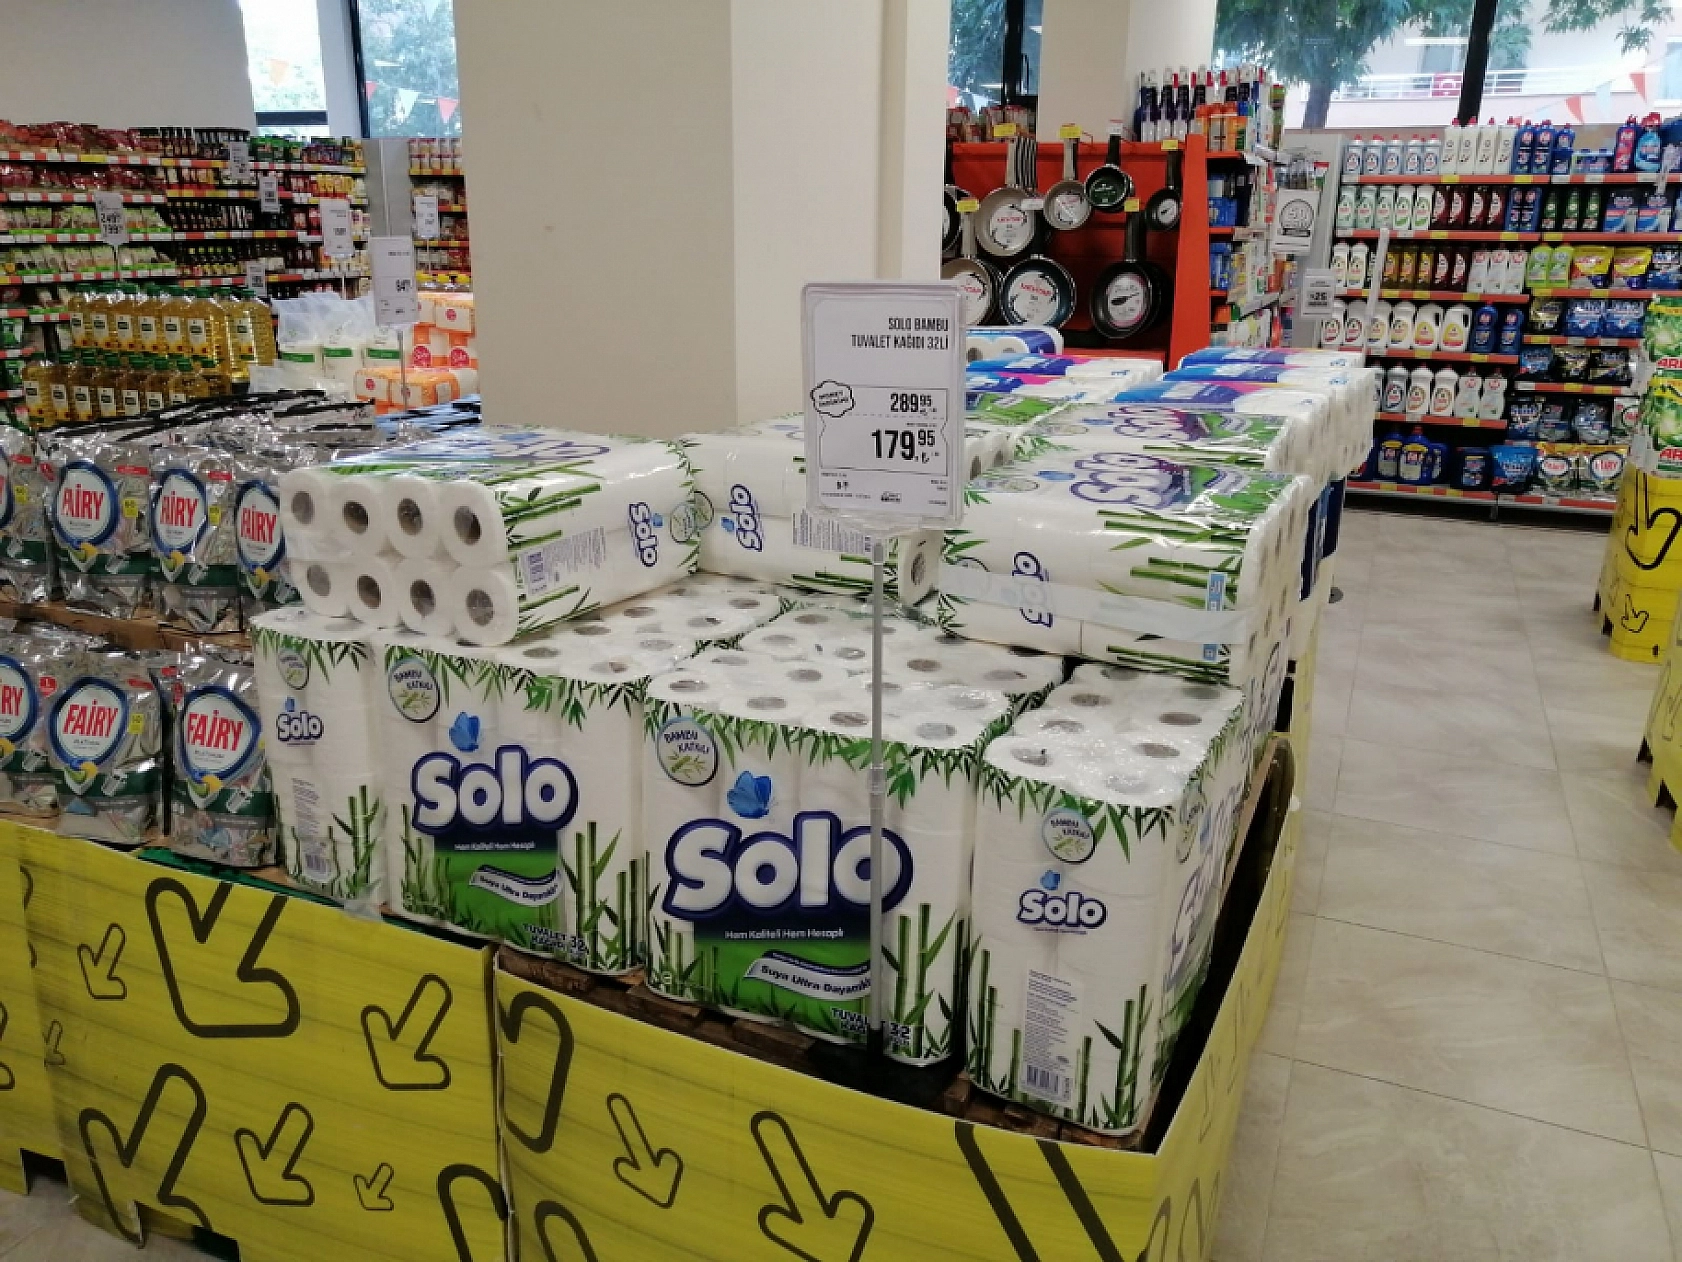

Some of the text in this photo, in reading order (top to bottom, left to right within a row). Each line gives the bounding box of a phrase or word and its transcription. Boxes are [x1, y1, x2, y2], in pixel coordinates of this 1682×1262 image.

[851, 334, 891, 348] TUVALET
[893, 333, 925, 349] KAĞIDI
[888, 317, 949, 332] SOLO BAMBU
[628, 501, 659, 568] Solo
[730, 483, 763, 553] Solo
[62, 698, 119, 738] FAIRY
[186, 709, 245, 752] FAIRY
[276, 710, 325, 742] Solo
[410, 744, 579, 836] Solo
[662, 810, 914, 922] Solo
[1016, 888, 1108, 930] Solo
[724, 930, 748, 939] Hem
[761, 965, 789, 982] Suya
[791, 974, 821, 991] Ultra
